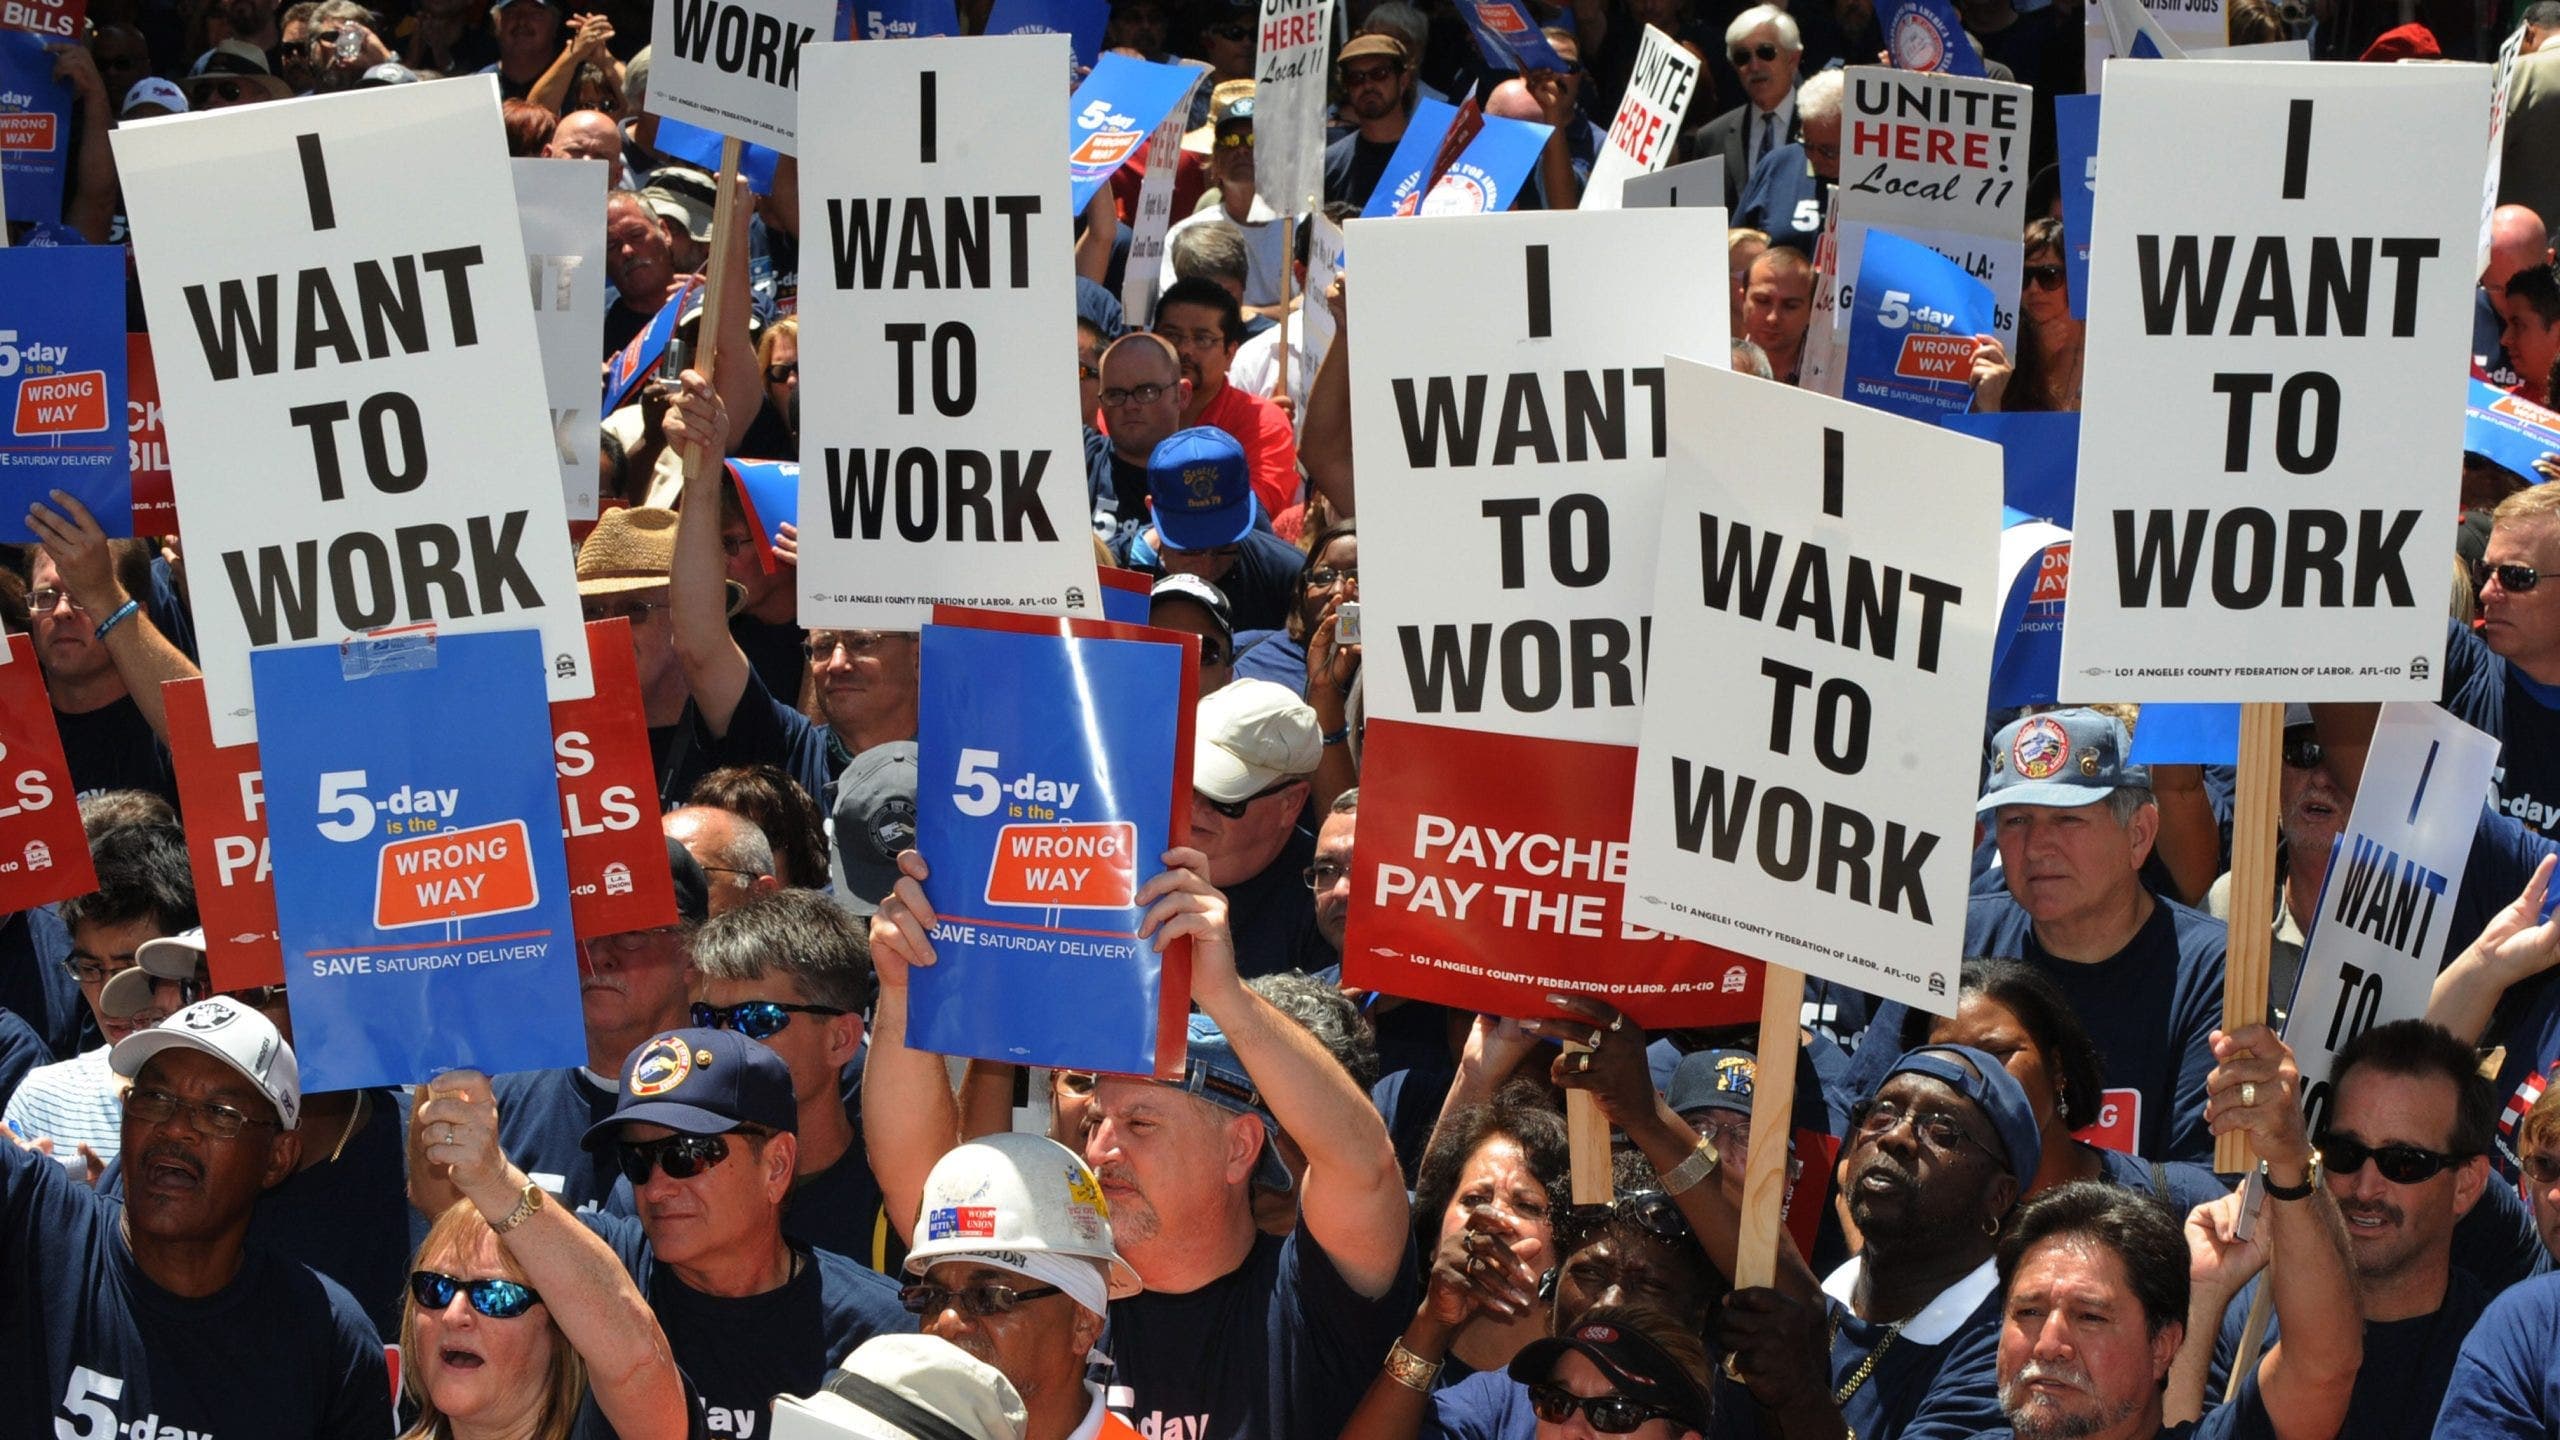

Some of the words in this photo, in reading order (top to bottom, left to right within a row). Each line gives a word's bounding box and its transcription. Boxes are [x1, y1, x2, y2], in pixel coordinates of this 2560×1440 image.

[3, 2, 74, 36] BILLS
[673, 0, 816, 92] WORK
[867, 11, 917, 40] 5-day
[1263, 9, 1325, 53] HERE!
[1261, 53, 1307, 84] Local
[1635, 37, 1694, 115] UNITE
[5, 131, 36, 144] WAY
[920, 71, 937, 163] I
[1077, 100, 1136, 131] 5-day
[1610, 94, 1672, 173] HERE!
[1856, 79, 2018, 130] UNITE
[1854, 120, 2012, 173] HERE!
[2282, 99, 2313, 199] I
[297, 133, 336, 231] I
[1850, 162, 1962, 201] Local
[1975, 177, 2014, 208] 11
[827, 195, 1042, 290] WANT
[183, 245, 484, 381] WANT
[1525, 244, 1553, 338] I
[1877, 290, 1955, 329] 5-day
[2136, 234, 2440, 337] WANT
[25, 364, 34, 374] is
[36, 363, 54, 374] the
[885, 321, 978, 417] TO
[1912, 340, 1972, 356] WRONG
[1919, 359, 1957, 374] WAY
[28, 381, 93, 402] WRONG
[37, 404, 78, 424] WAY
[1858, 382, 1888, 398] SAVE
[2213, 371, 2341, 474] TO
[12, 456, 60, 466] SATURDAY
[61, 455, 113, 466] DELIVERY
[291, 390, 429, 501] TO
[1823, 427, 1844, 518] I
[824, 447, 1058, 543] WORK
[1482, 493, 1610, 589] TO
[2111, 507, 2423, 610] WORK
[222, 509, 546, 647] WORK
[834, 594, 848, 604] LOS
[850, 594, 883, 605] ANGELES
[885, 595, 915, 606] COUNTY
[917, 595, 966, 607] FEDERATION
[967, 597, 979, 606] OF
[1019, 597, 1058, 607] AFL-CIO
[1699, 511, 1963, 673] WANT
[1398, 615, 1651, 713] WOR
[2115, 668, 2133, 677] LOS
[2137, 667, 2184, 678] ANGELES
[2187, 667, 2231, 677] COUNTY
[2234, 666, 2299, 677] FEDERATION
[2301, 666, 2315, 676] OF
[2359, 666, 2401, 675] AFL-CIO
[1760, 657, 1872, 776] TO
[316, 770, 458, 842] 5-day
[952, 748, 1080, 817] 5-day
[1008, 803, 1022, 817] is
[1027, 804, 1054, 820] the
[2407, 740, 2439, 825] I
[386, 818, 403, 835] is
[408, 817, 437, 833] the
[395, 837, 508, 876] WRONG
[1011, 835, 1117, 858] WRONG
[1671, 756, 1940, 925] WORK
[416, 874, 485, 908] WAY
[1025, 867, 1090, 891] WAY
[1374, 863, 1484, 920] PAY
[1494, 885, 1606, 938] THE
[2335, 833, 2448, 960] WANT
[312, 956, 372, 977] SAVE
[375, 953, 462, 973] SATURDAY
[466, 943, 548, 967] DELIVERY
[930, 923, 975, 945] SAVE
[979, 932, 1056, 953] SATURDAY
[1059, 941, 1136, 959] DELIVERY
[1410, 953, 1430, 966] LOS
[1433, 957, 1484, 978] ANGELES
[1486, 968, 1535, 985] COUNTY
[1537, 976, 1609, 994] FEDERATION
[1611, 982, 1626, 994] OF
[1671, 981, 1715, 994] AFL-CIO
[1670, 902, 1687, 914] LOS
[1690, 908, 1731, 925] ANGELES
[1734, 919, 1773, 938] COUNTY
[1775, 931, 1831, 956] FEDERATION
[1833, 950, 1845, 960] OF
[1884, 966, 1922, 984] AFL-CIO
[2325, 961, 2382, 1052] TO
